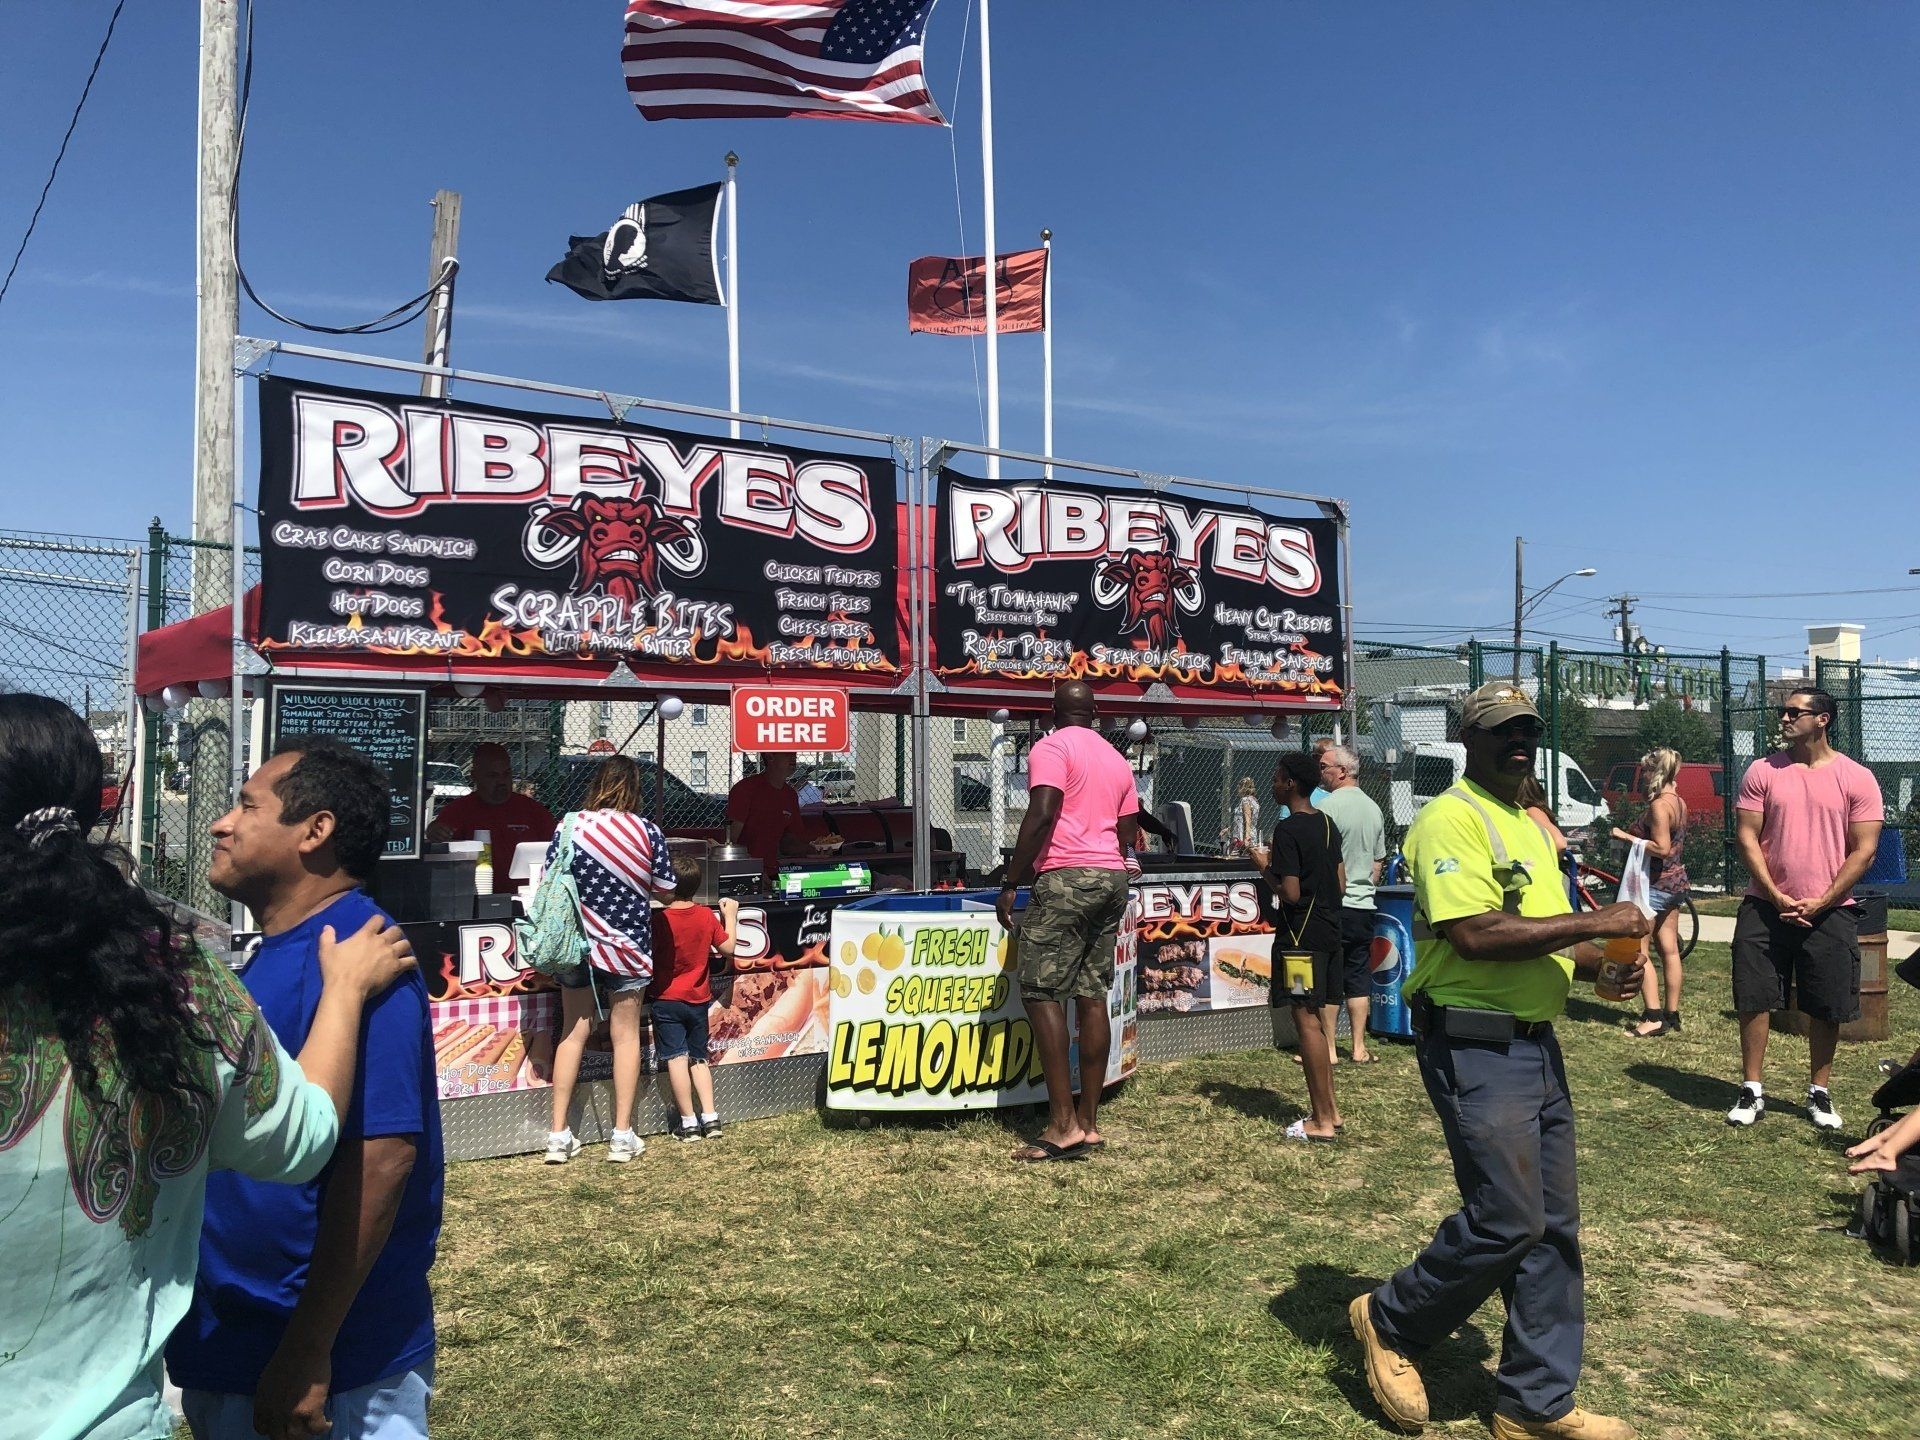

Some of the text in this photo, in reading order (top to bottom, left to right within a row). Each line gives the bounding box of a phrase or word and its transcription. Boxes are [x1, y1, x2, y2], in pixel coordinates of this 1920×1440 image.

[290, 391, 877, 554] RIBEYES
[274, 522, 475, 557] CRAB CAKE SANDWICH
[949, 482, 1322, 597] RIBEYES
[325, 559, 429, 584] CORN DOGS
[765, 561, 881, 587] CHICKEN TENDERS
[332, 592, 423, 615] HOT DOGS
[493, 585, 734, 638] SCRAPPLE BITES
[776, 589, 870, 612] FRENCH FRIES
[779, 616, 869, 638] CHEESE FRIES
[976, 607, 1007, 623] RIBEYE
[1034, 609, 1058, 625] BONE
[1214, 602, 1333, 632] HEAVY CUT RIBEYE
[289, 623, 384, 645] KIELBASA
[544, 632, 692, 657] WITH APPLE BUTTER
[962, 631, 1018, 656] ROAST
[1019, 633, 1063, 658] PORK
[1245, 626, 1270, 640] STEAK
[769, 642, 881, 664] FRESH LEMONADE
[976, 655, 1023, 671] PROVOLONE
[1091, 643, 1140, 666] STEAK
[1142, 651, 1161, 665] ON
[1171, 649, 1212, 671] STICK
[1220, 643, 1334, 671] ITALIAN SAUSAGE
[1289, 669, 1316, 683] ONIONS
[283, 694, 406, 708] WILDWOOD BLOCK PARTY
[744, 695, 837, 718] ORDER
[281, 709, 324, 718] TOMAHAWK
[326, 709, 351, 719] STEAK
[281, 718, 309, 727] RIBEYE
[312, 719, 340, 727] CHEESE
[343, 719, 370, 728] STEAK
[281, 726, 309, 734] RIBEYE
[312, 727, 336, 735] STEAK
[756, 722, 827, 744] HERE
[1131, 882, 1259, 924] EYES
[802, 903, 828, 927] ICE
[797, 927, 832, 945] LEMONA
[911, 928, 990, 967] FRESH
[886, 973, 1010, 1016] SQUEEZED
[1371, 992, 1398, 1006] epsi
[440, 1065, 466, 1081] HOT
[465, 1062, 500, 1078] DOGS
[442, 1077, 511, 1096] CORN DOGS
